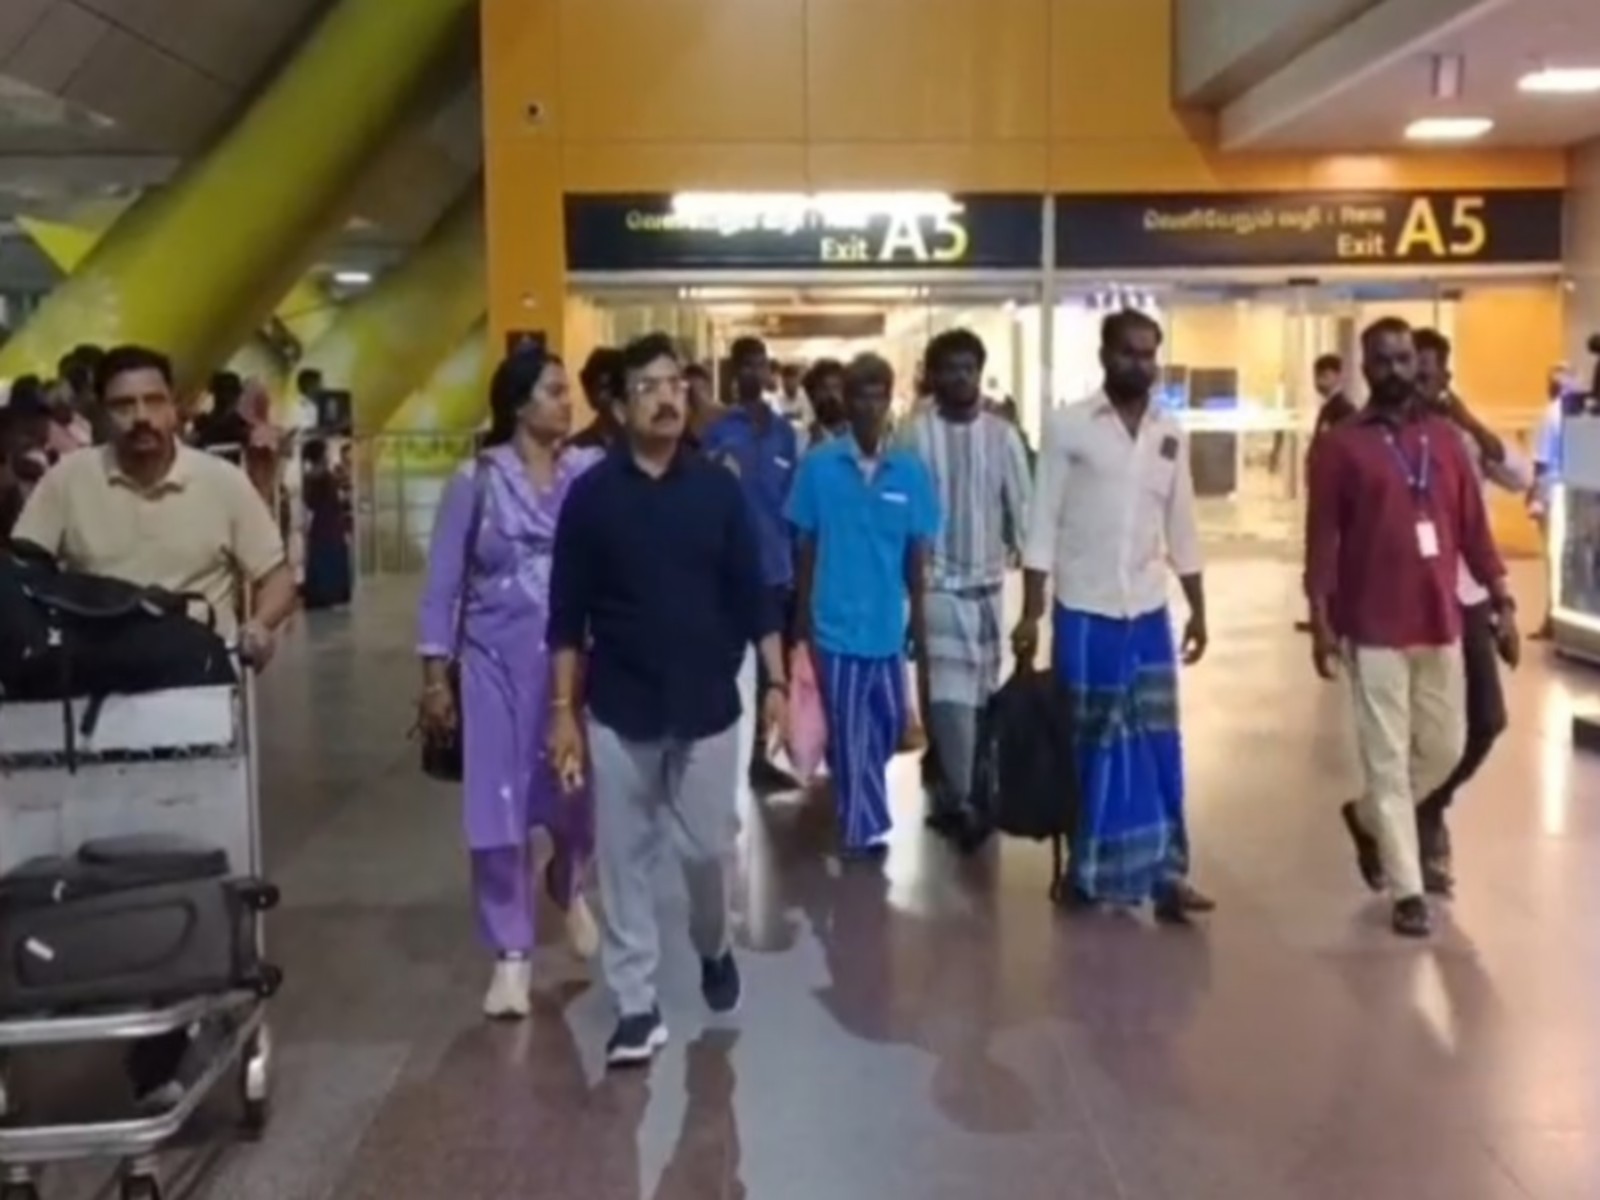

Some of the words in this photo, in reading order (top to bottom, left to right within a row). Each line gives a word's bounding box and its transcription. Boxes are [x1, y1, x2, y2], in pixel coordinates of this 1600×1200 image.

[821, 235, 868, 262] Exit
[878, 201, 968, 261] A5
[1337, 231, 1385, 258] Exit
[1395, 197, 1486, 257] A5
